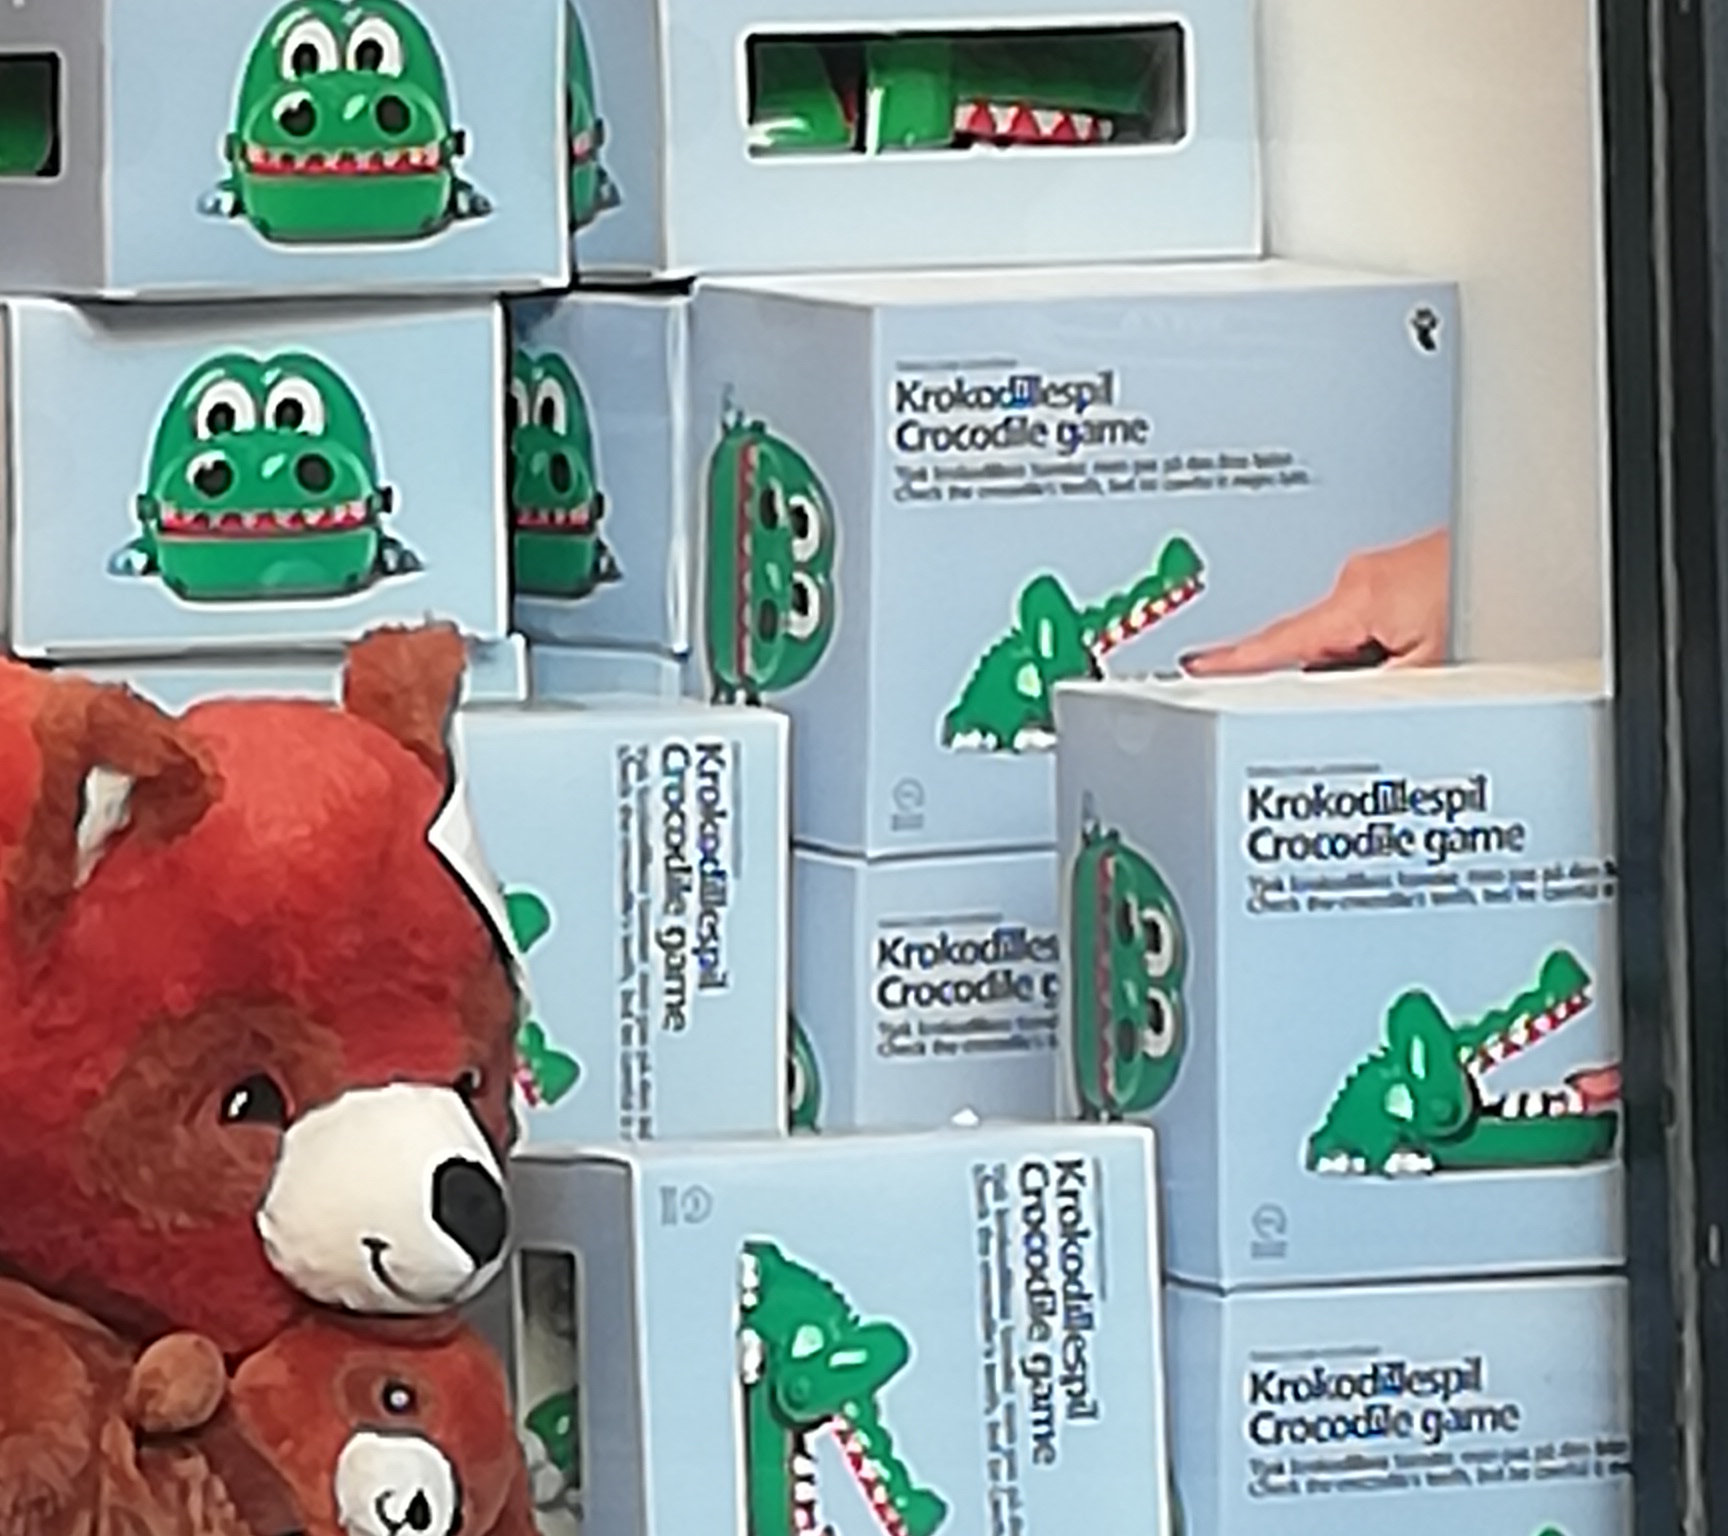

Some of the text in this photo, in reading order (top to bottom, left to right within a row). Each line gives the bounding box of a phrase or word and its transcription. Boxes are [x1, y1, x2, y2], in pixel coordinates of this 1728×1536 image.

[895, 370, 1114, 414] Krokodillespil
[895, 415, 1150, 457] Crocodile game
[1247, 774, 1488, 822] Krokodillespil
[691, 743, 729, 991] Krokodillespil
[1248, 821, 1527, 865] Crocodile game
[655, 743, 692, 1033] Crocodile game
[877, 969, 1034, 1010] Crocodile
[1018, 1161, 1059, 1466] Crocodile game
[1053, 1159, 1100, 1421] Krokodillespil
[1248, 1357, 1482, 1406] Krokodillespil
[1248, 1400, 1520, 1446] Crocodile game
